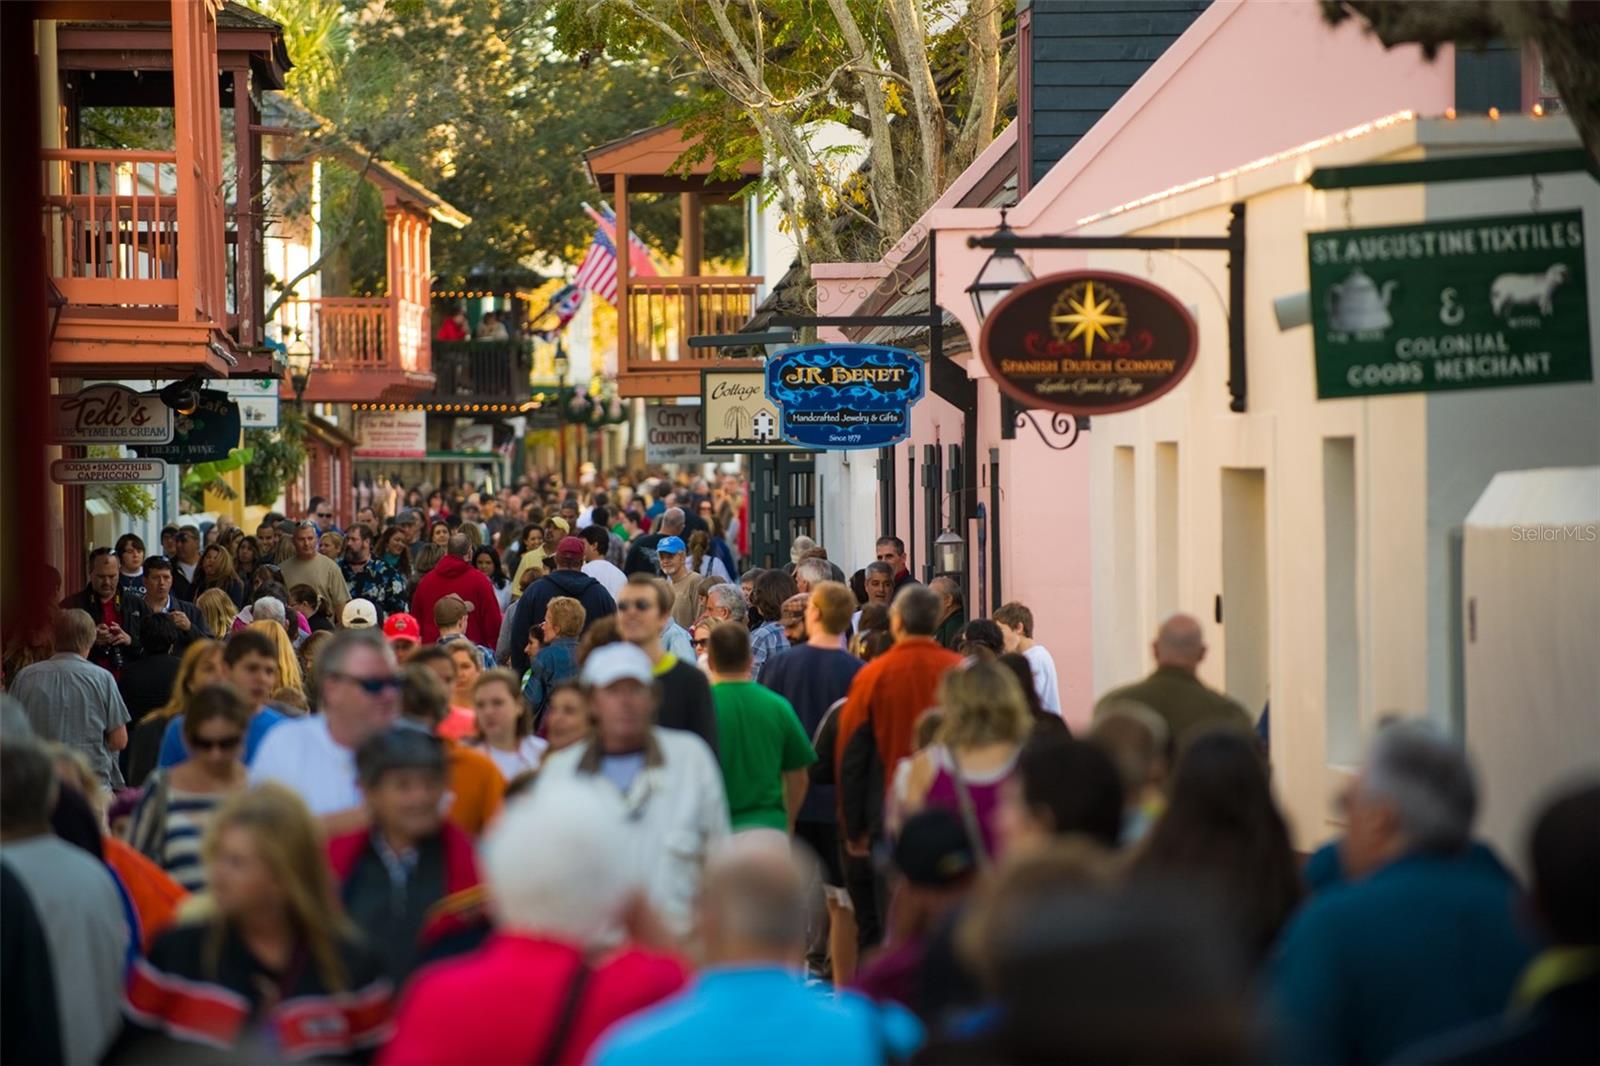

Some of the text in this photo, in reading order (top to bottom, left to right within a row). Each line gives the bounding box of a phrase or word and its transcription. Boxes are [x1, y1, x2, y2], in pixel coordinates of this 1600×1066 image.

[1395, 332, 1510, 360] COLONIAL
[1001, 358, 1176, 373] SPANISH DUTCH CONVOY
[1434, 352, 1551, 381] MERCHANT
[711, 380, 760, 400] Cottage
[60, 391, 151, 433] Tedi's
[792, 411, 898, 424] Handcrafted Jewelry & Gifts
[110, 427, 127, 437] ICE
[129, 427, 167, 437] CREAM
[829, 434, 847, 442] Since
[188, 444, 216, 455] WINE
[64, 463, 153, 472] SODAS SMOOTHIES
[77, 472, 140, 480] CAPPUCCINO
